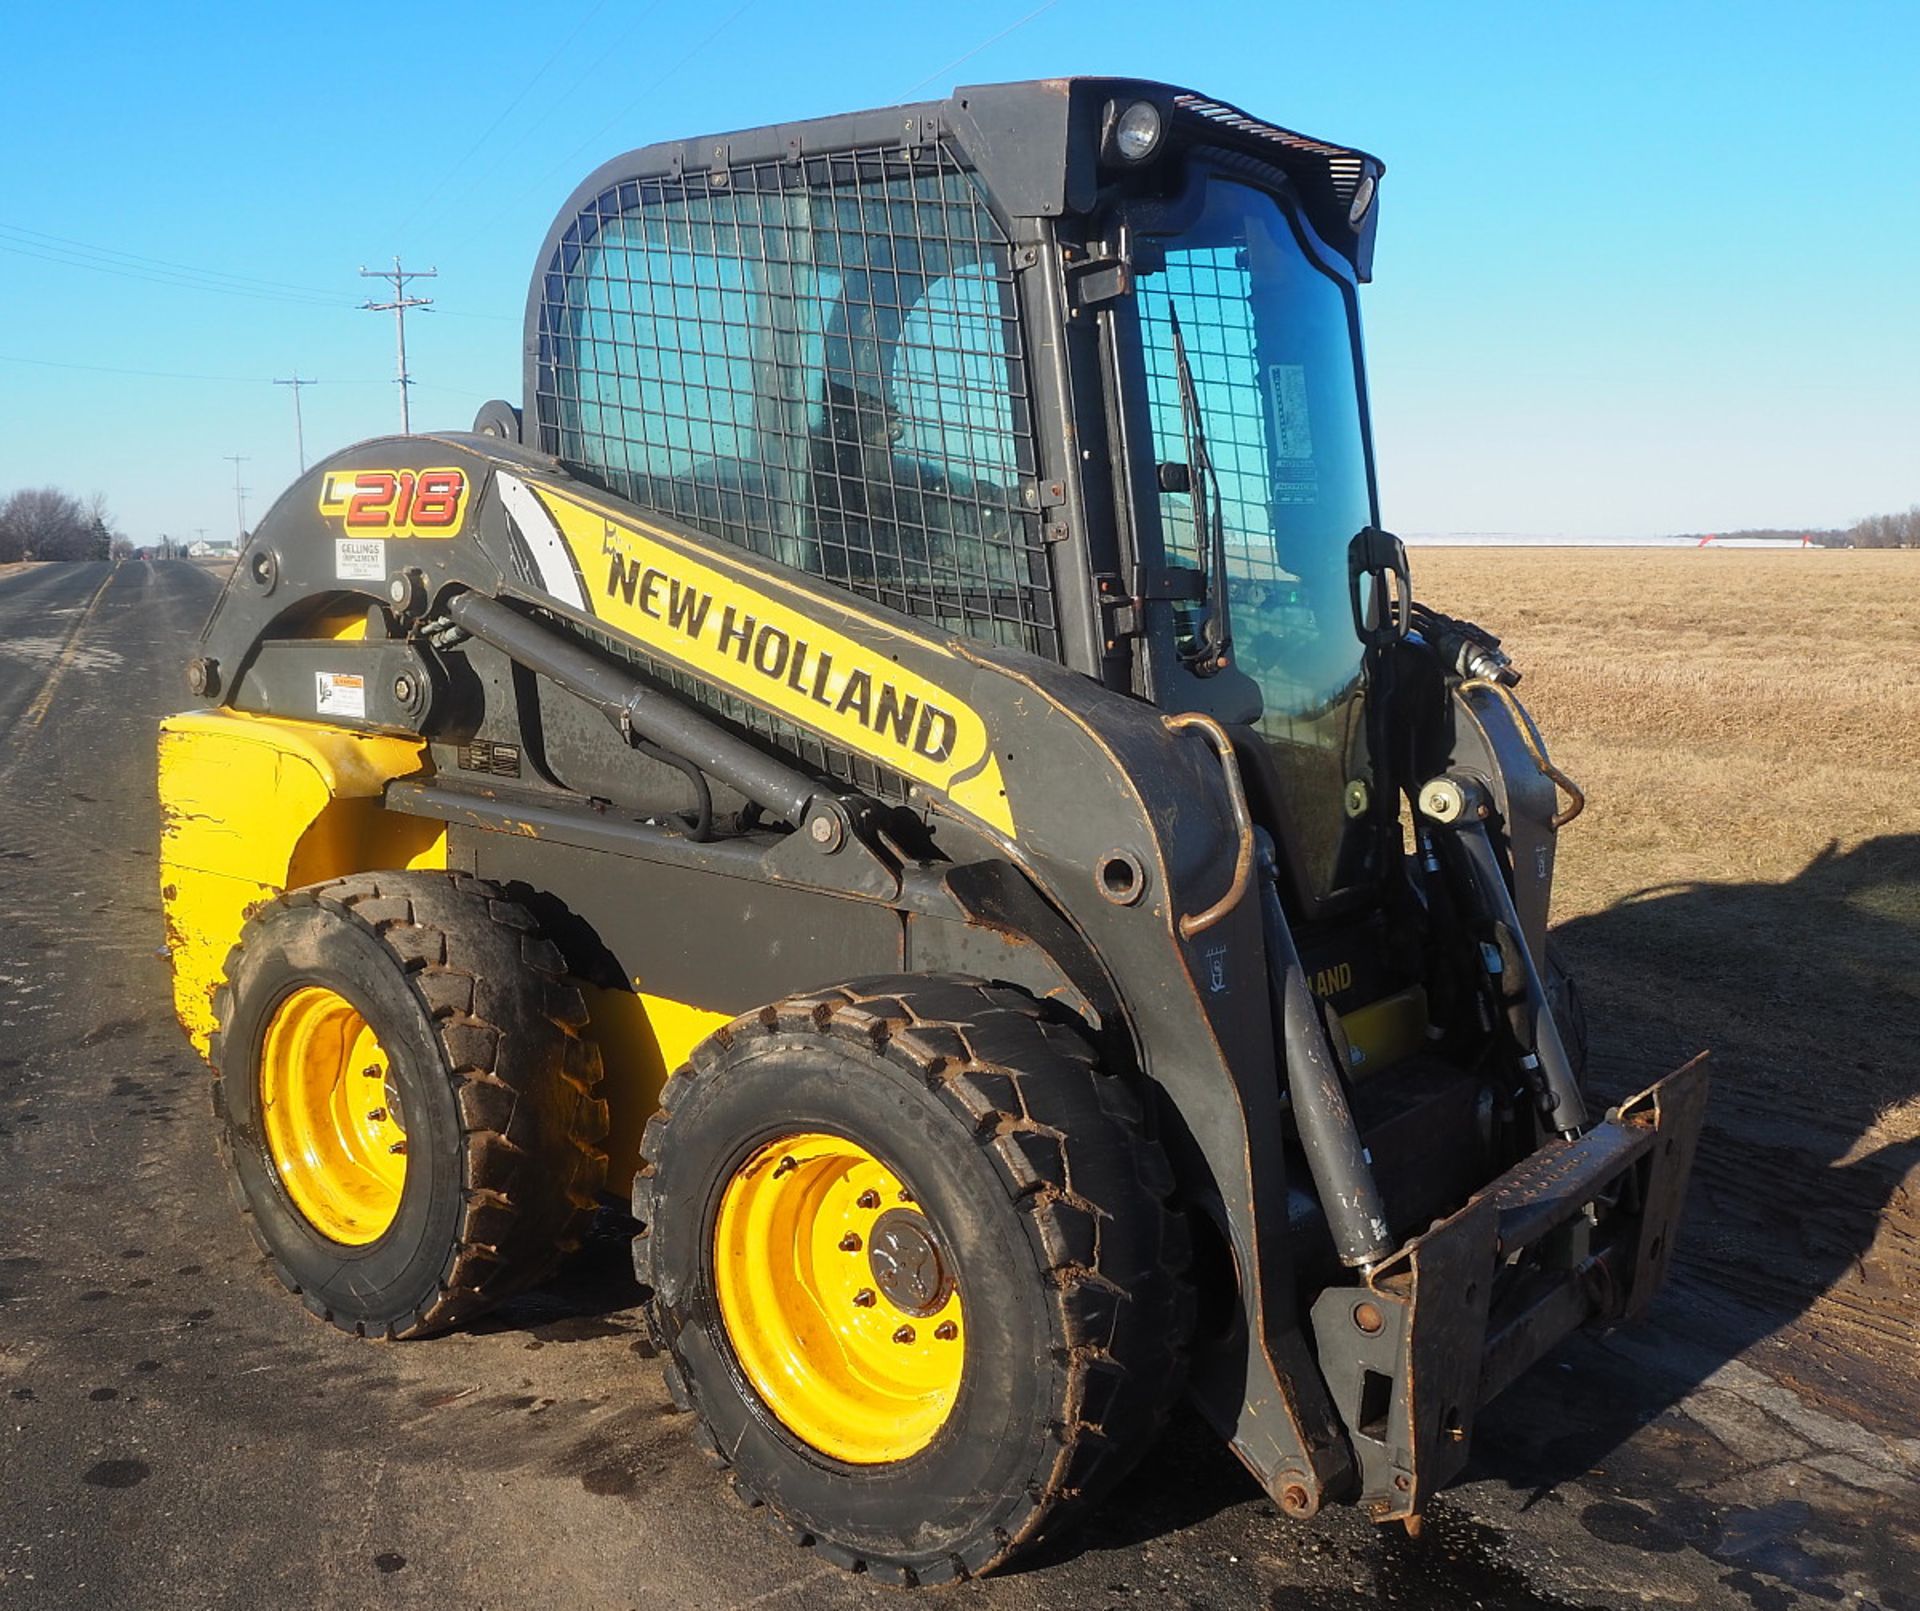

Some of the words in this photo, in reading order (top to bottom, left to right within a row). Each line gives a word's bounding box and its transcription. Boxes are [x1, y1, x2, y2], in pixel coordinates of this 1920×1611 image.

[322, 472, 465, 527] L218
[341, 543, 380, 554] GELLINGS
[606, 552, 713, 641] NEW
[716, 605, 958, 764] HOLLAND
